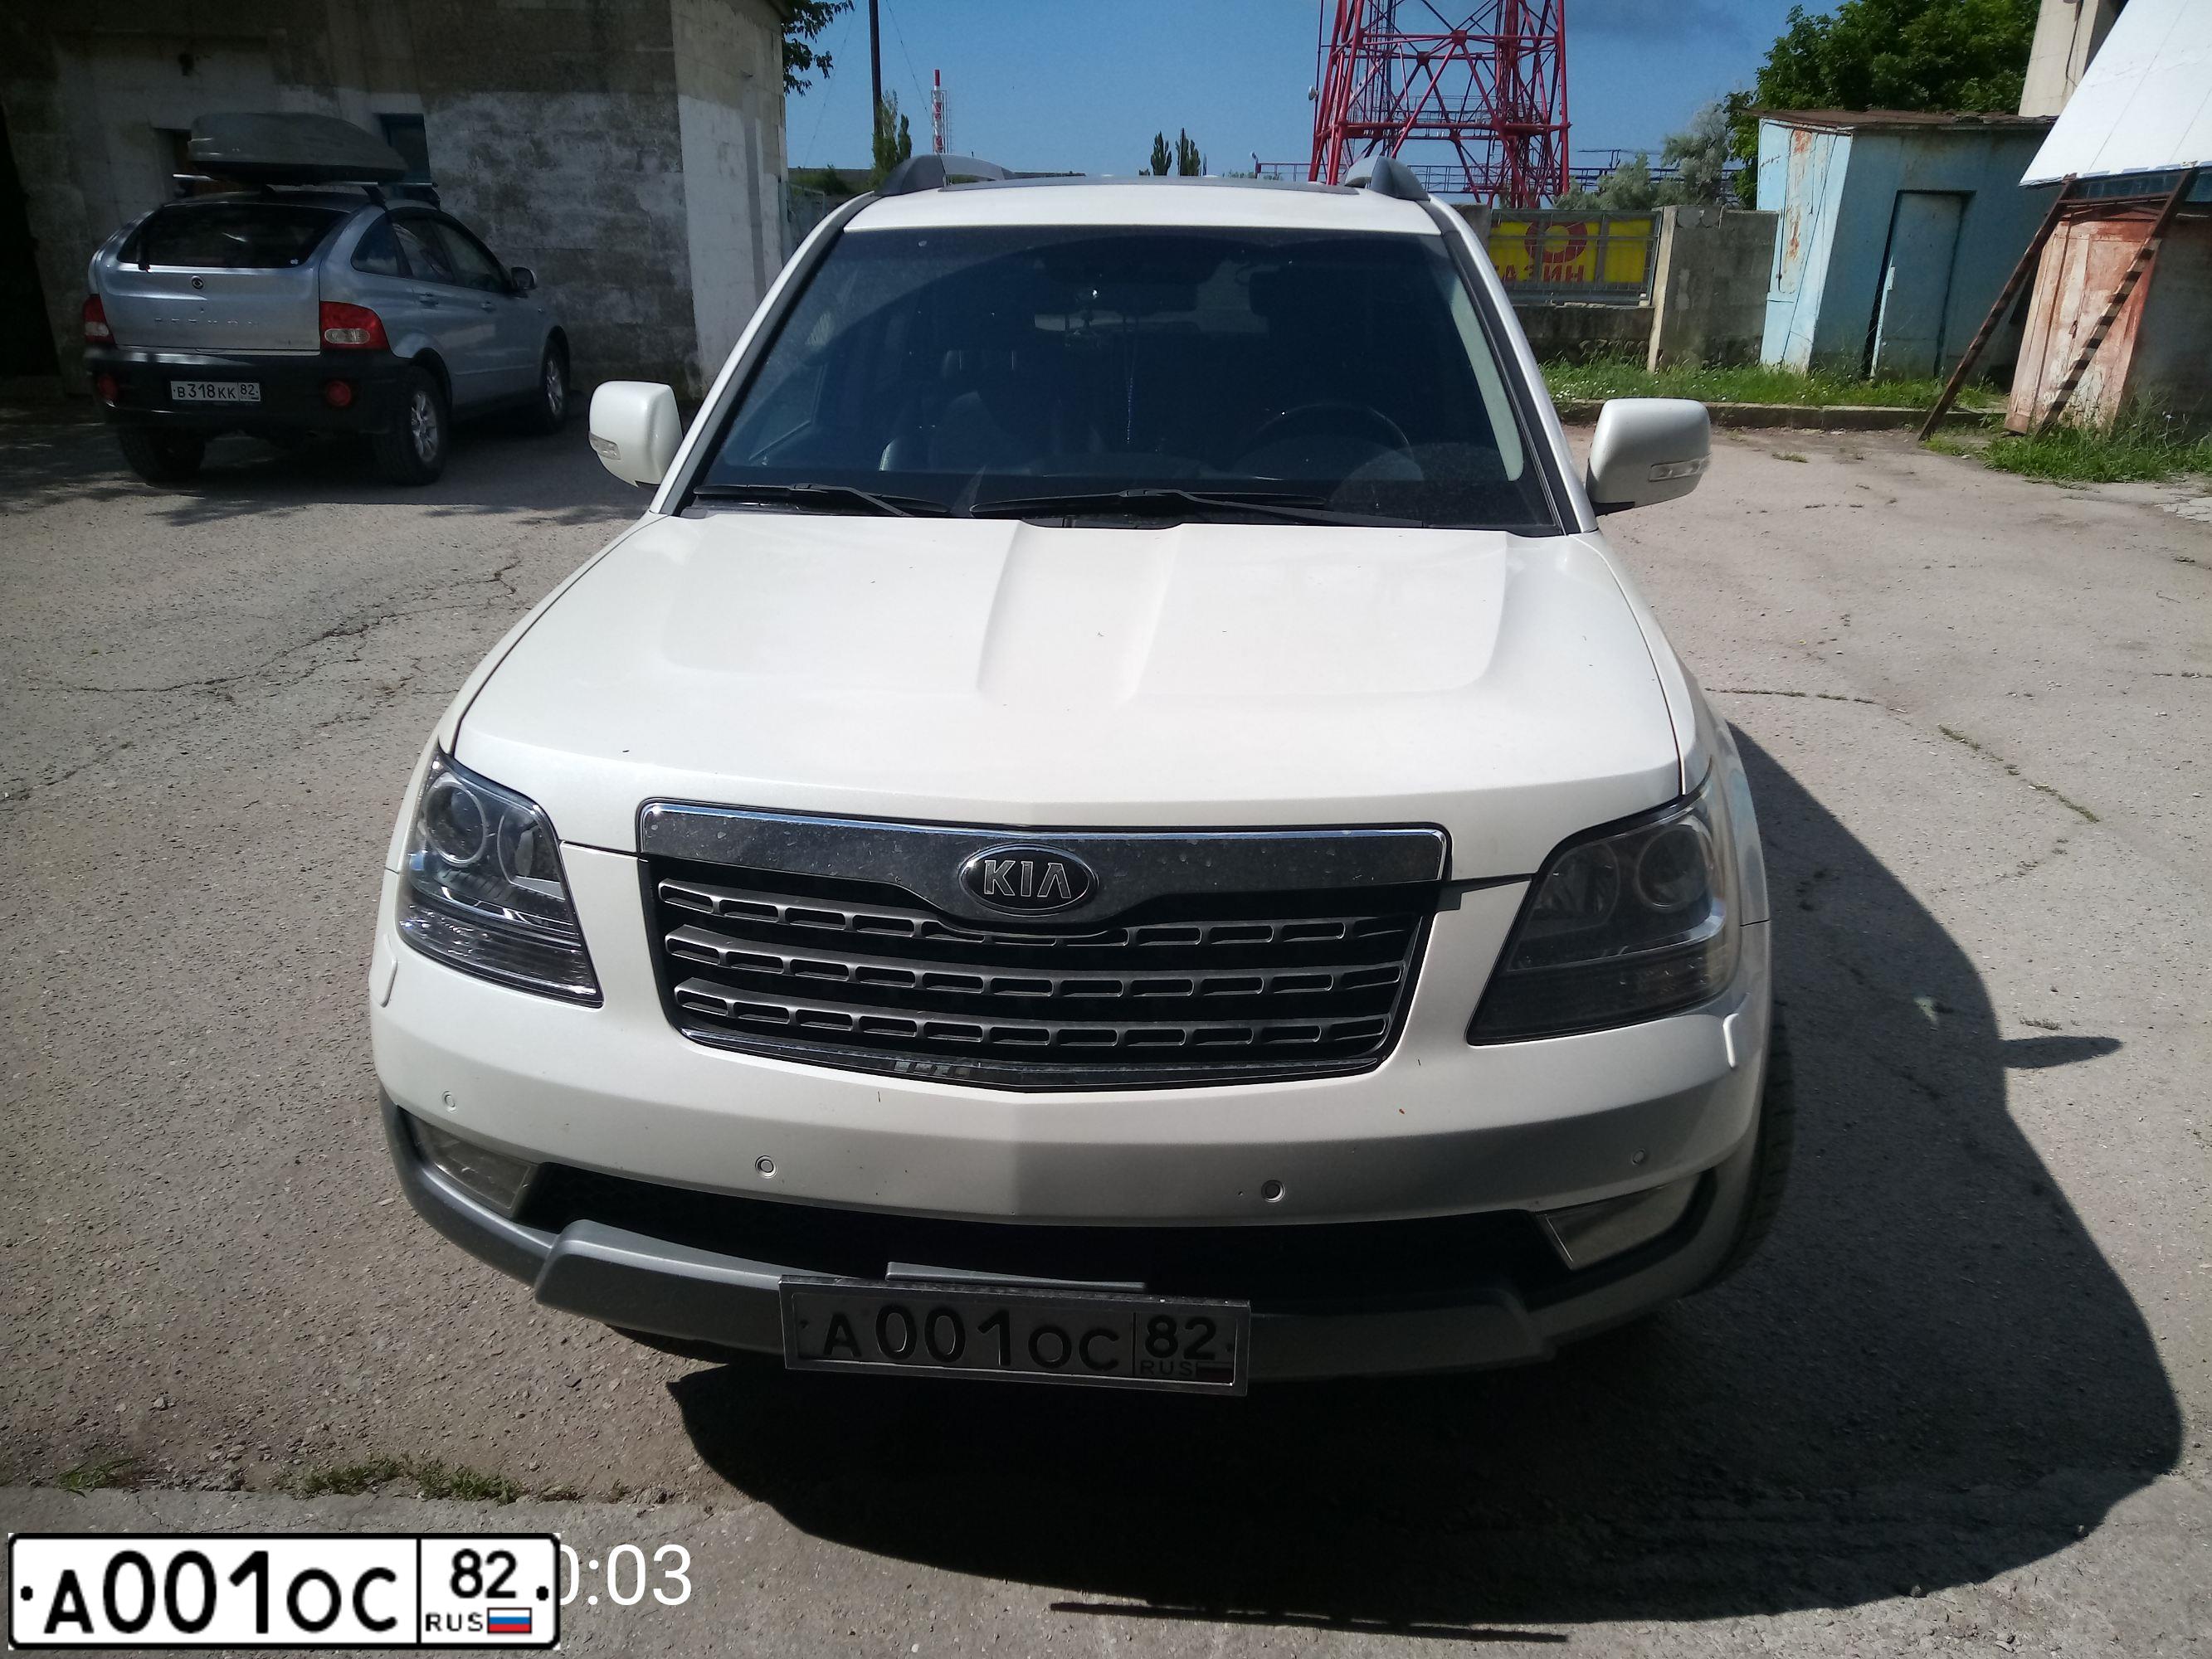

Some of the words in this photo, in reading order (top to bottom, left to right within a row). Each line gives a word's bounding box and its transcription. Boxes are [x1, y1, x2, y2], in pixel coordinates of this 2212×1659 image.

[1494, 264, 1585, 283] АЗИН
[240, 384, 255, 396] 82
[983, 859, 1072, 899] KIA
[1144, 1314, 1216, 1361] 82
[1139, 1359, 1193, 1379] RUS
